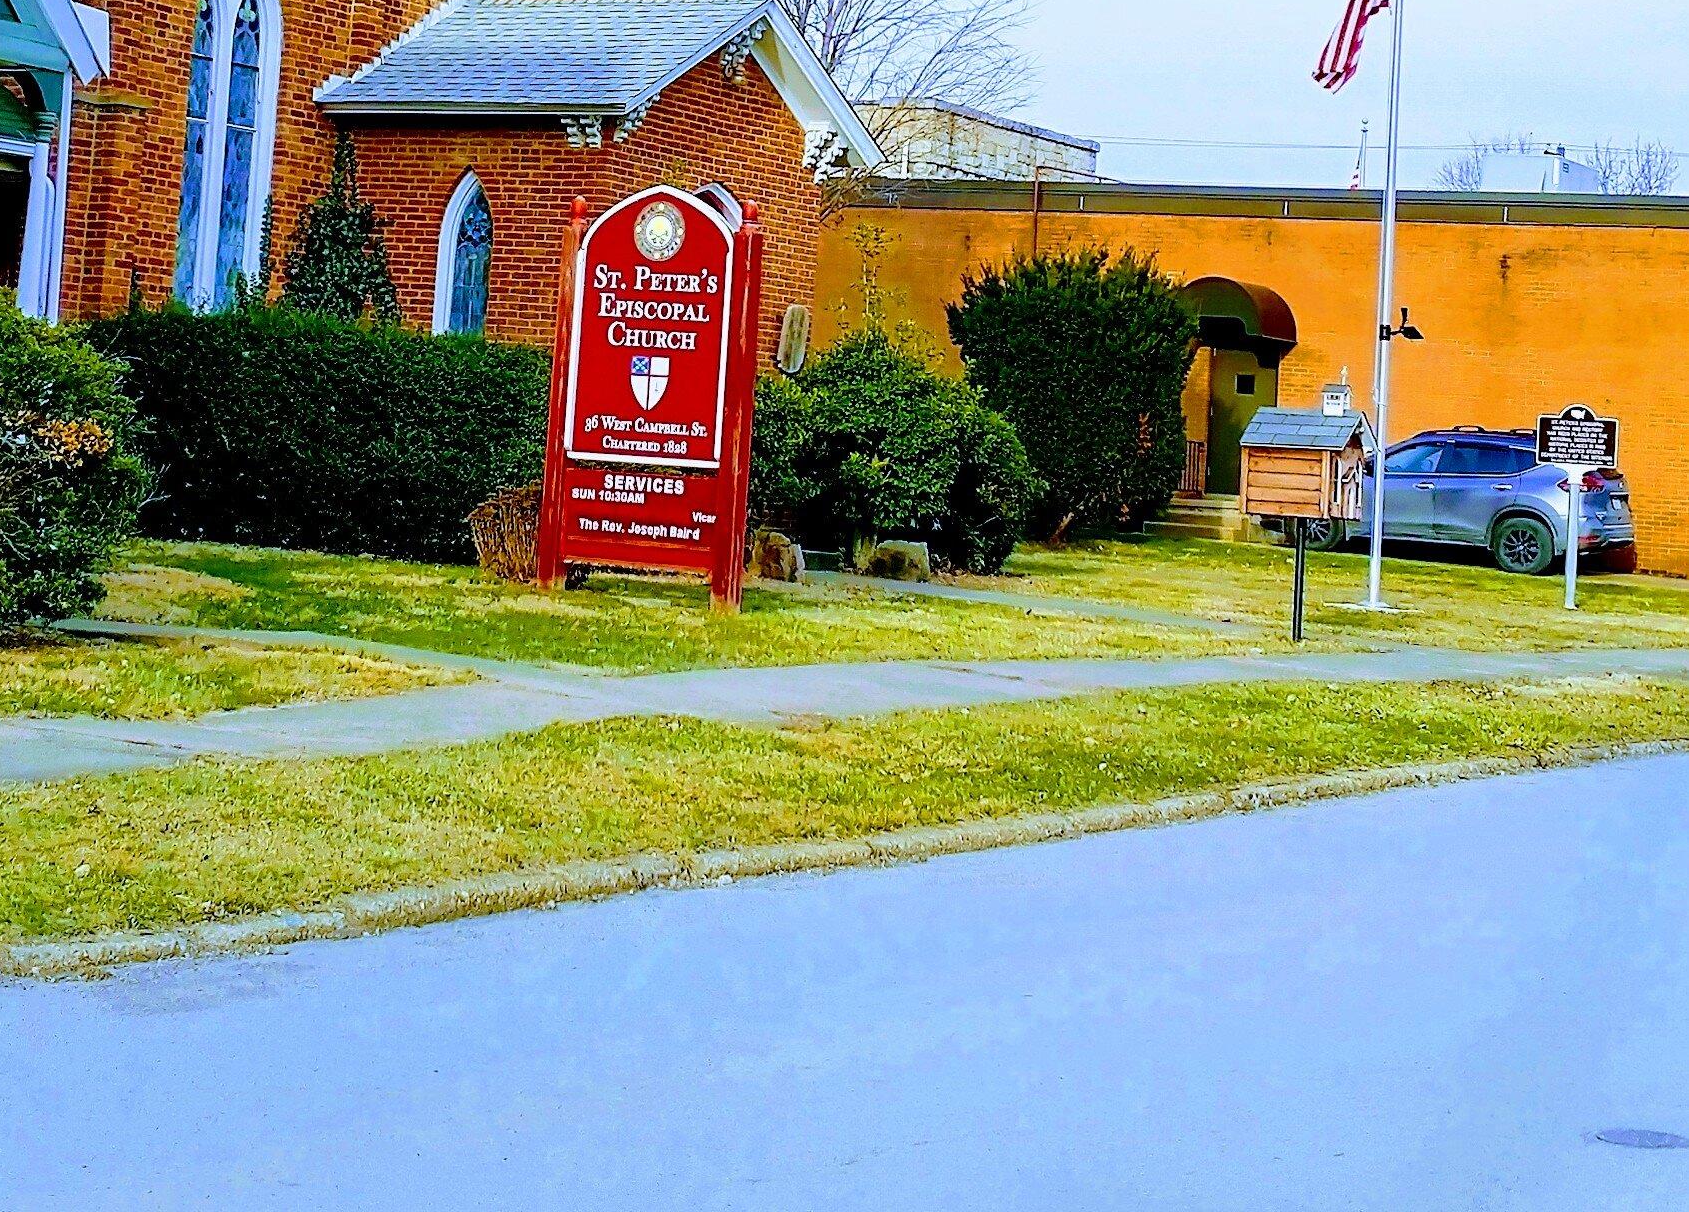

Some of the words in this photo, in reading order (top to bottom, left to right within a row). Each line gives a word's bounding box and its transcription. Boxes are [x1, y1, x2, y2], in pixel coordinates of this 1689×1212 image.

[594, 264, 626, 290] ST.
[634, 266, 718, 293] PETER'S
[598, 293, 709, 322] EPISCOPAL
[608, 321, 697, 350] CHURCH
[601, 416, 632, 431] WEST
[634, 418, 689, 435] CAMPBELL
[691, 422, 708, 437] ST.
[603, 436, 660, 452] CHARTERED
[663, 441, 687, 454] 1828
[604, 475, 684, 495] SERVICES
[572, 488, 595, 499] SUN
[598, 492, 645, 504] 10:30AM
[692, 512, 717, 523] Vicar
[579, 518, 598, 530] The
[602, 520, 625, 533] Rev.
[628, 523, 667, 539] Joseph
[670, 528, 700, 540] Baird
